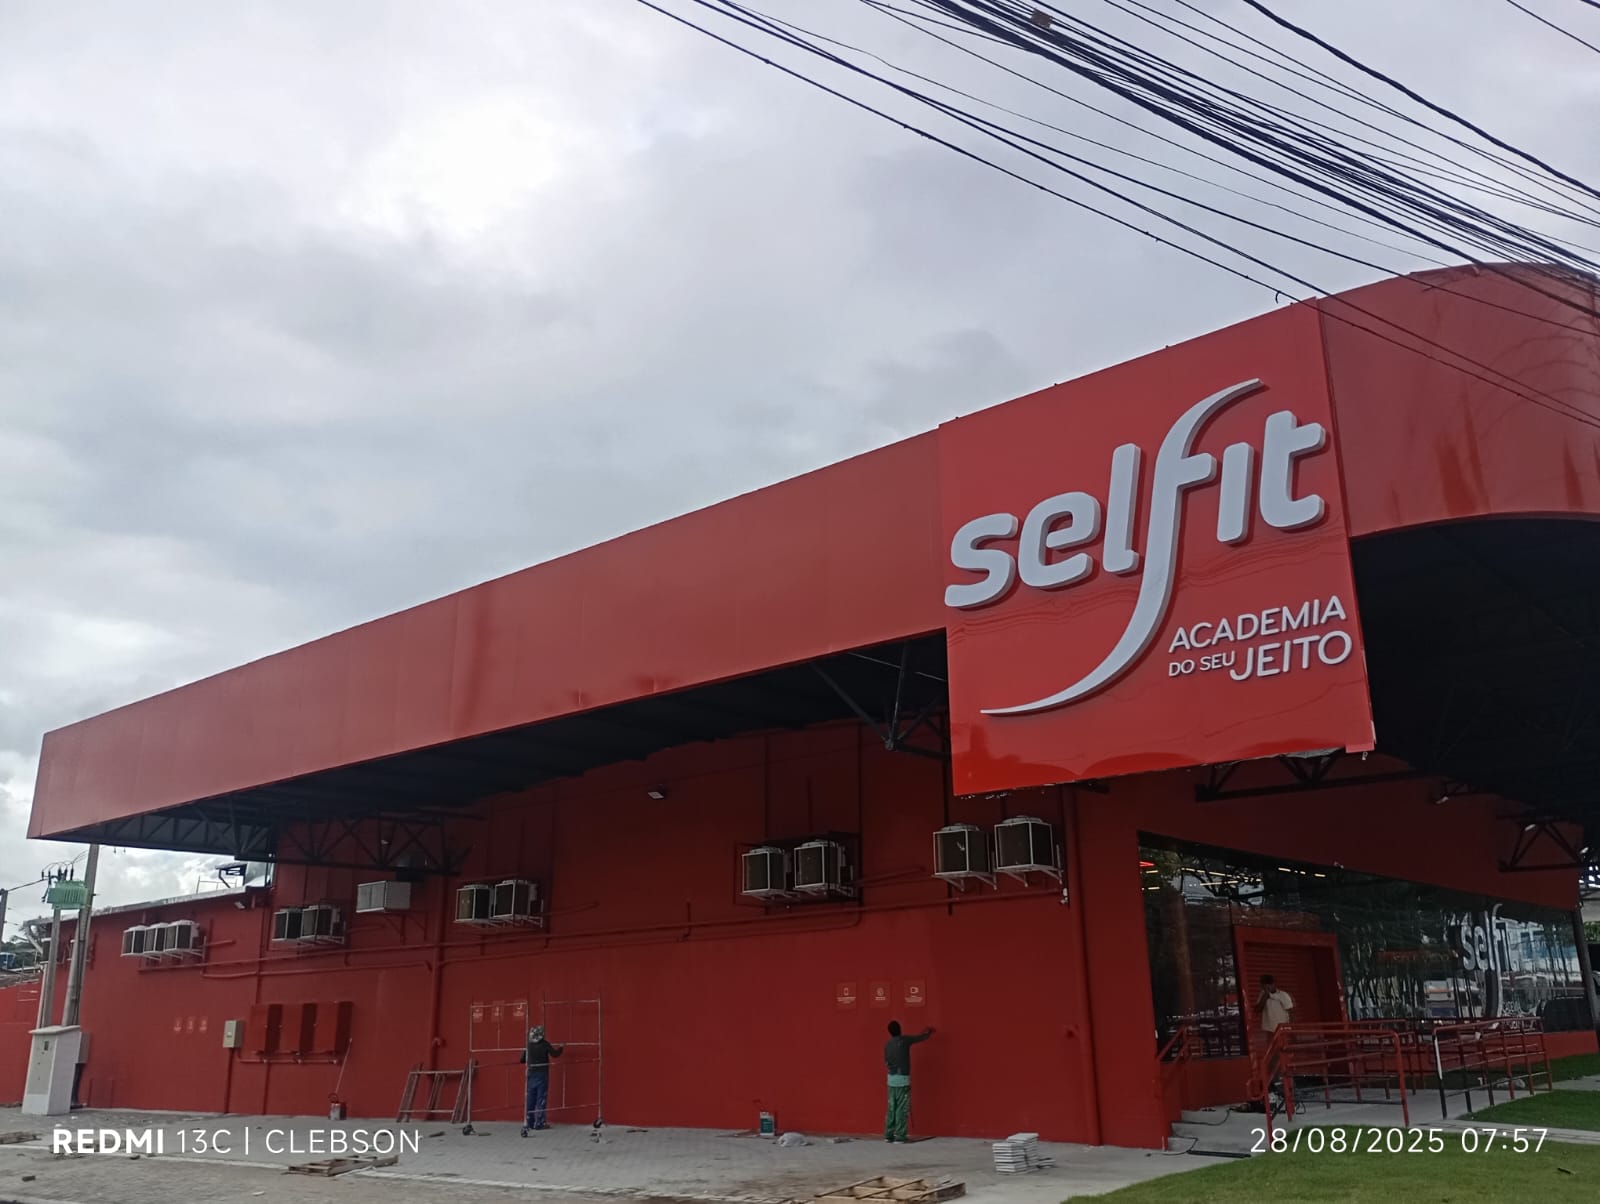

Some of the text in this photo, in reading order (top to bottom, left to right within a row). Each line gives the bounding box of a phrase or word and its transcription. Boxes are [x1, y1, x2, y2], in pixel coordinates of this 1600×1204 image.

[944, 377, 1327, 716] selfit
[1168, 595, 1347, 654] ACADEMIA
[1168, 630, 1353, 681] DO SEU JEITO
